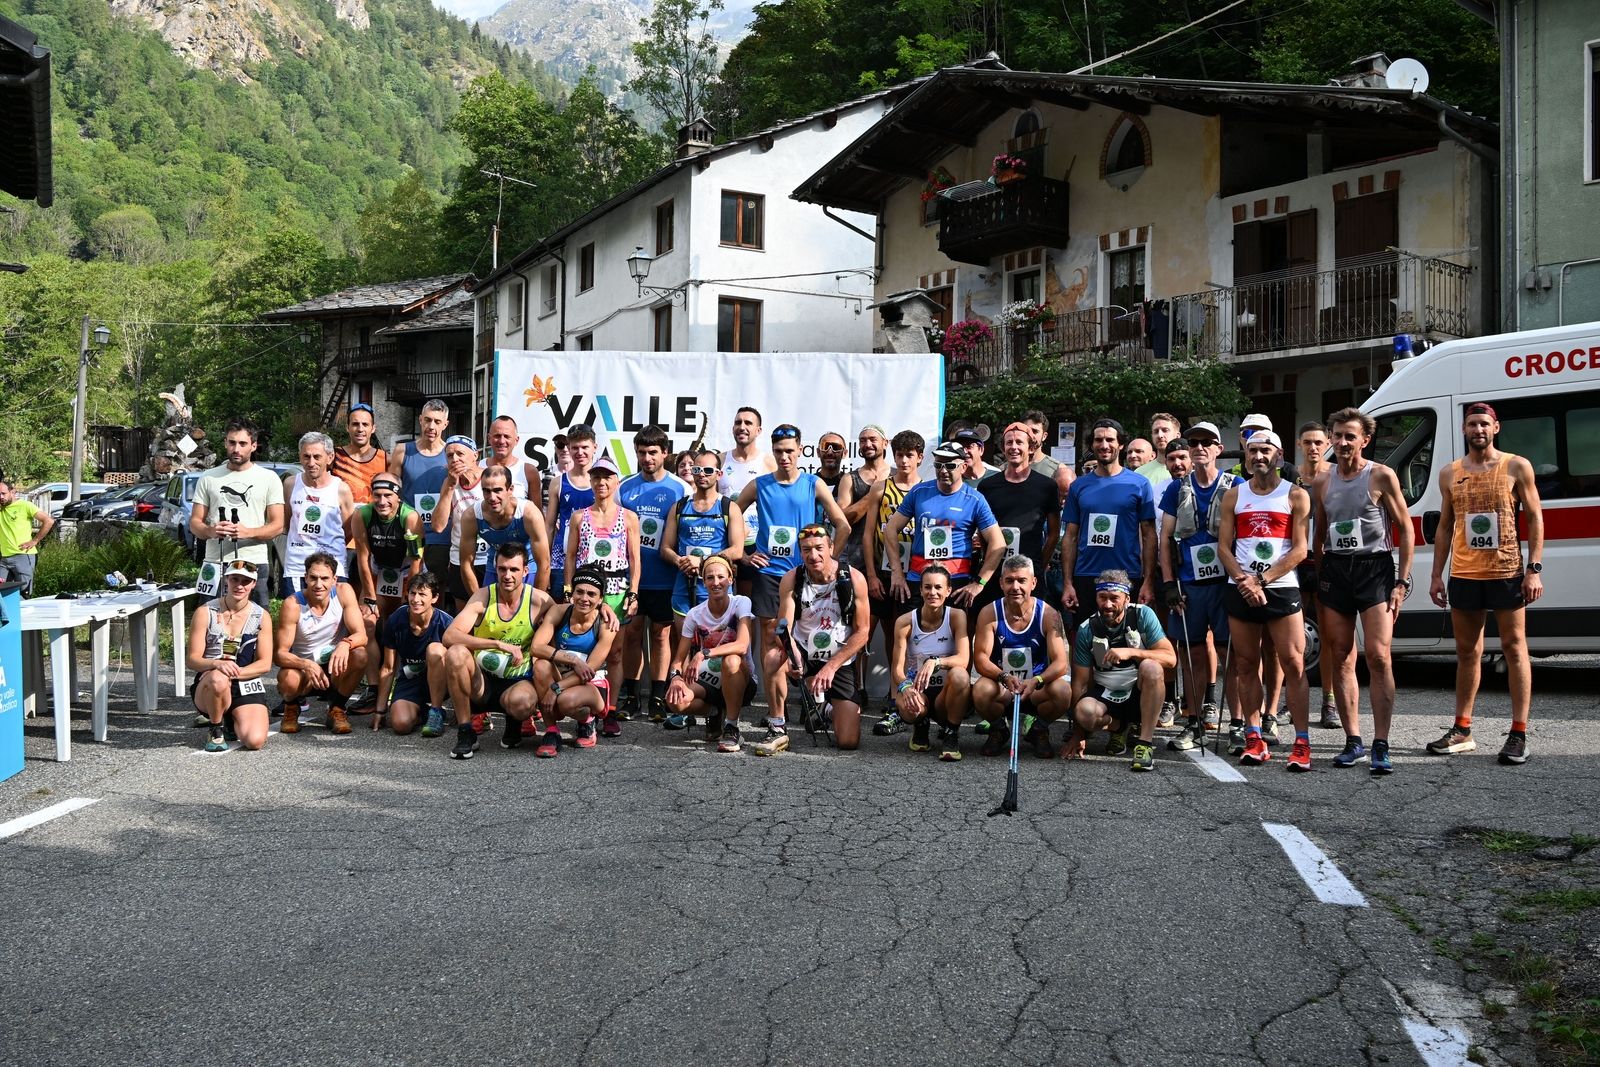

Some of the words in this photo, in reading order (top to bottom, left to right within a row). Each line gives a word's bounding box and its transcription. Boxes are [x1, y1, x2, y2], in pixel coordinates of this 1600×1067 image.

[1504, 346, 1600, 379] CROCE
[547, 394, 697, 433] VALLE
[302, 523, 321, 534] 459
[1091, 535, 1110, 545] 468
[1336, 537, 1358, 548] 456
[1470, 537, 1493, 547] 494
[772, 546, 791, 556] 509
[929, 547, 949, 558] 499
[1198, 565, 1220, 577] 504
[197, 582, 214, 593] 507
[380, 585, 399, 595] 465
[812, 651, 832, 659] 471
[699, 670, 720, 686] 470
[928, 675, 944, 685] 86
[244, 681, 263, 693] 506
